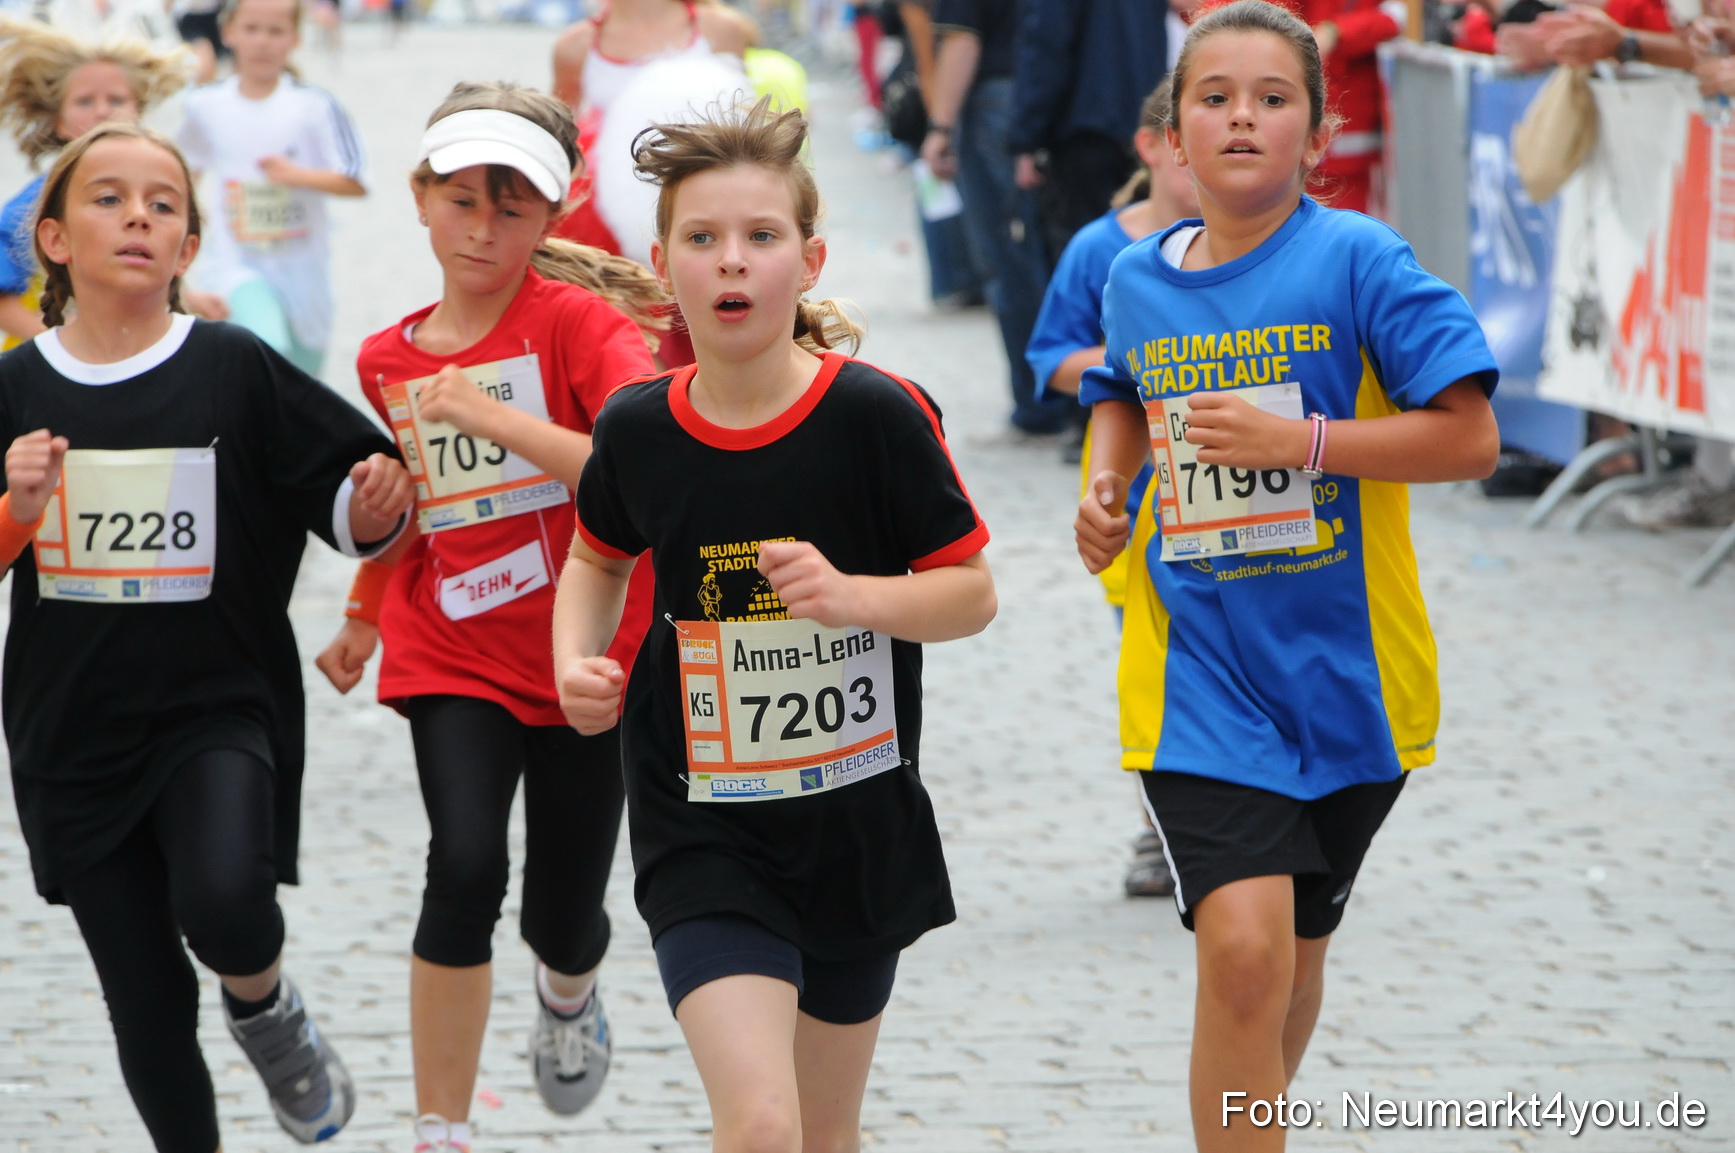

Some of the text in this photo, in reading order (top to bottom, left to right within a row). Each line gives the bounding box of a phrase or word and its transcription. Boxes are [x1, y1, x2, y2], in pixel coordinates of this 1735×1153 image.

[1144, 324, 1331, 367] NEUMARKTER
[1141, 355, 1289, 396] STADTLAUF
[1157, 462, 1170, 484] K5
[1180, 462, 1290, 505] 7196
[78, 511, 196, 552] 7228
[699, 536, 796, 559] NEUMAR
[1239, 520, 1312, 541] PFLEIDERER
[468, 569, 511, 602] DEHN
[733, 630, 875, 672] Anna-Lena
[690, 692, 714, 717] K5
[740, 676, 877, 743] 7203
[824, 741, 895, 777] PFLEIDERER
[826, 757, 897, 787] AKTIENGESELLSCHAFT
[711, 778, 767, 791] BOCK
